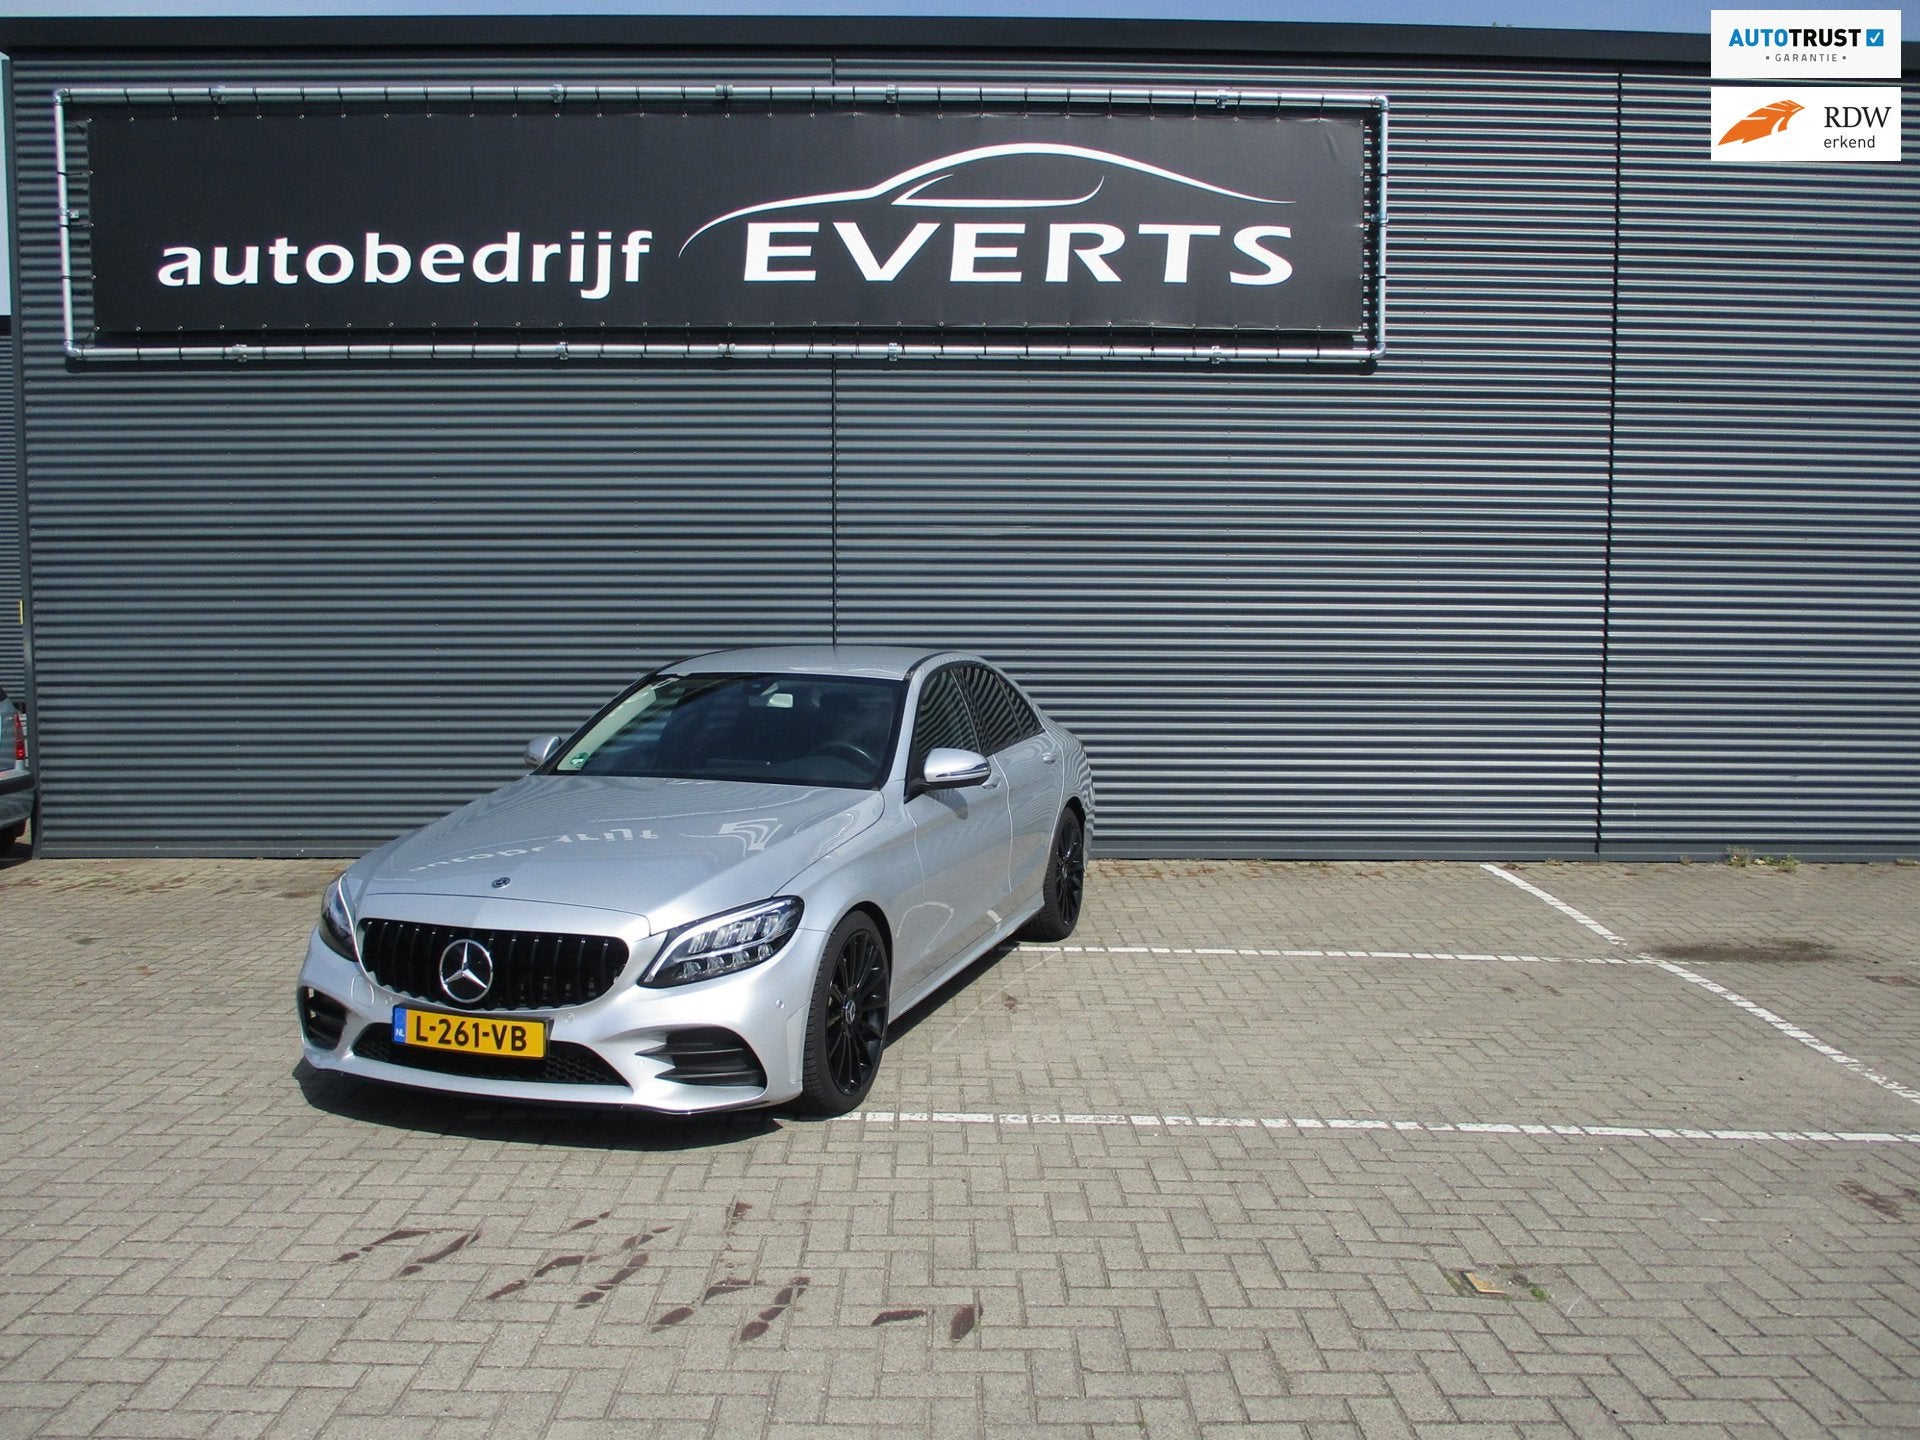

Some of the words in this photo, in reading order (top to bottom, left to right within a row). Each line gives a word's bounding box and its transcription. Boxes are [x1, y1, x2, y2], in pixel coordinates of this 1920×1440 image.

[157, 230, 653, 300] autobedrijf
[743, 221, 1293, 286] EVERTS
[415, 1015, 527, 1052] L-261-VB
